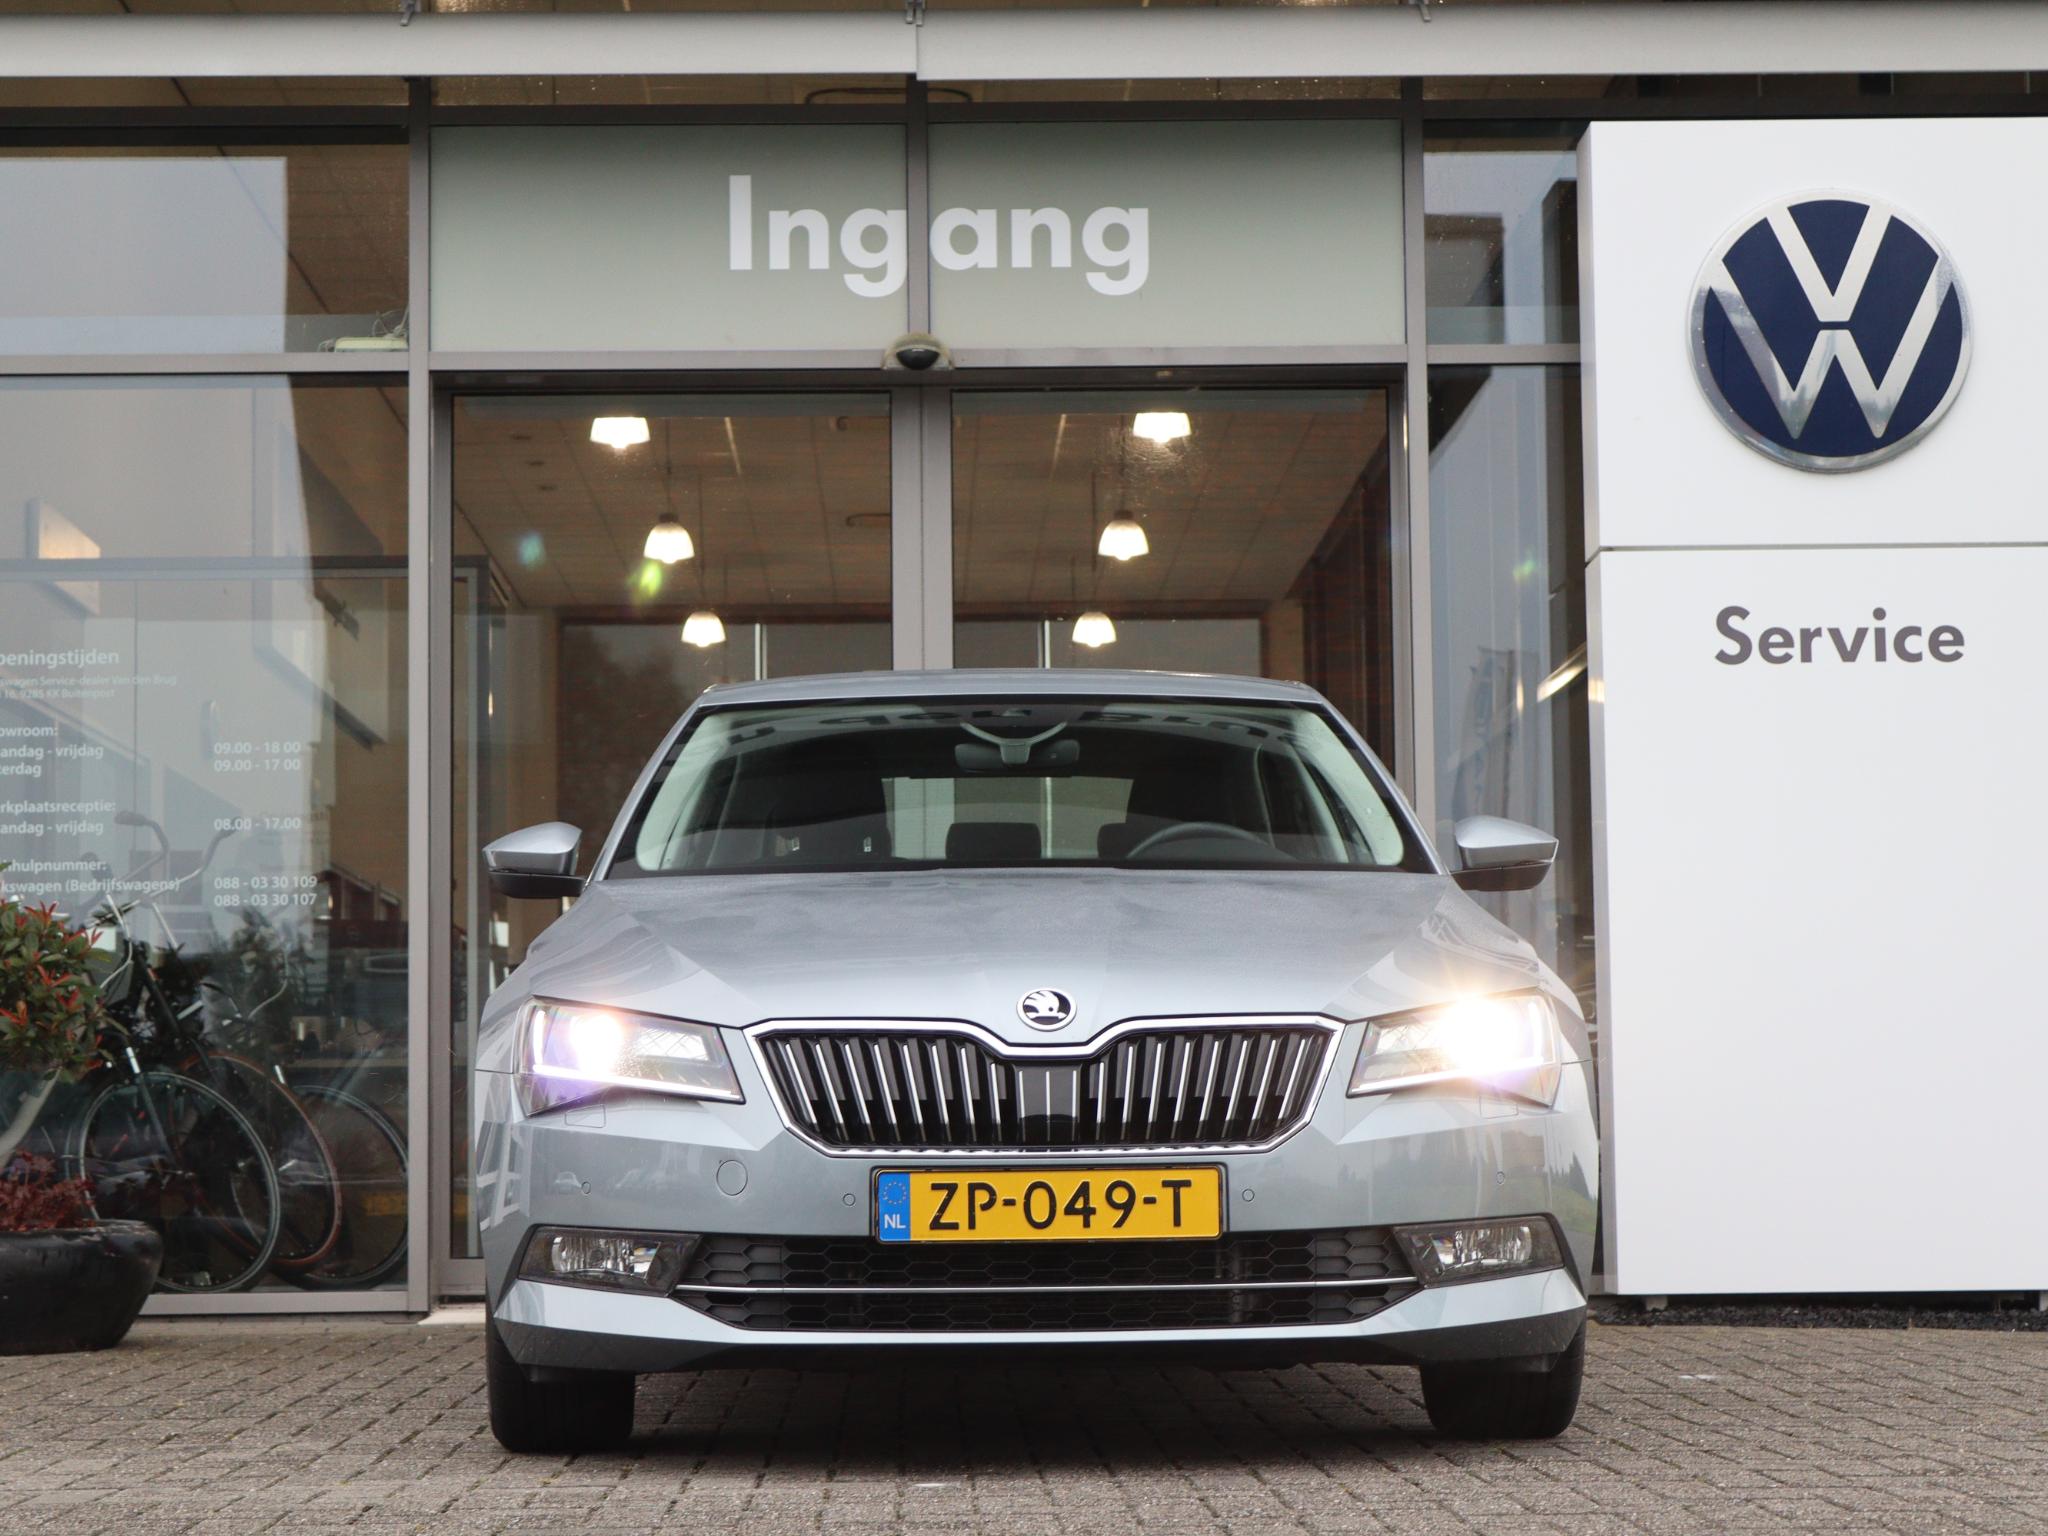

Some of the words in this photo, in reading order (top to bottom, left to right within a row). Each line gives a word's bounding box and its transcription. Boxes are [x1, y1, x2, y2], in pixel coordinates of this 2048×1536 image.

[728, 174, 1149, 298] Ingang
[1715, 605, 1965, 665] Service
[55, 744, 104, 759] vrijdag
[213, 742, 252, 754] 09.00
[263, 741, 301, 753] 1800
[213, 759, 252, 772] 09.00
[263, 758, 301, 771] 1700
[55, 819, 104, 835] vrijdag
[213, 818, 252, 830] 08.00
[263, 817, 302, 830] 17.00
[65, 878, 180, 895] (Bedrijfswagens)
[214, 877, 240, 889] 088
[251, 876, 268, 889] 03
[271, 876, 288, 888] 30
[293, 875, 318, 888] 109
[214, 894, 240, 907] 088
[251, 894, 268, 906] 03
[271, 894, 288, 906] 30
[293, 893, 317, 906] 107
[884, 1213, 906, 1229] NL
[929, 1179, 1192, 1231] ZP-049-T
